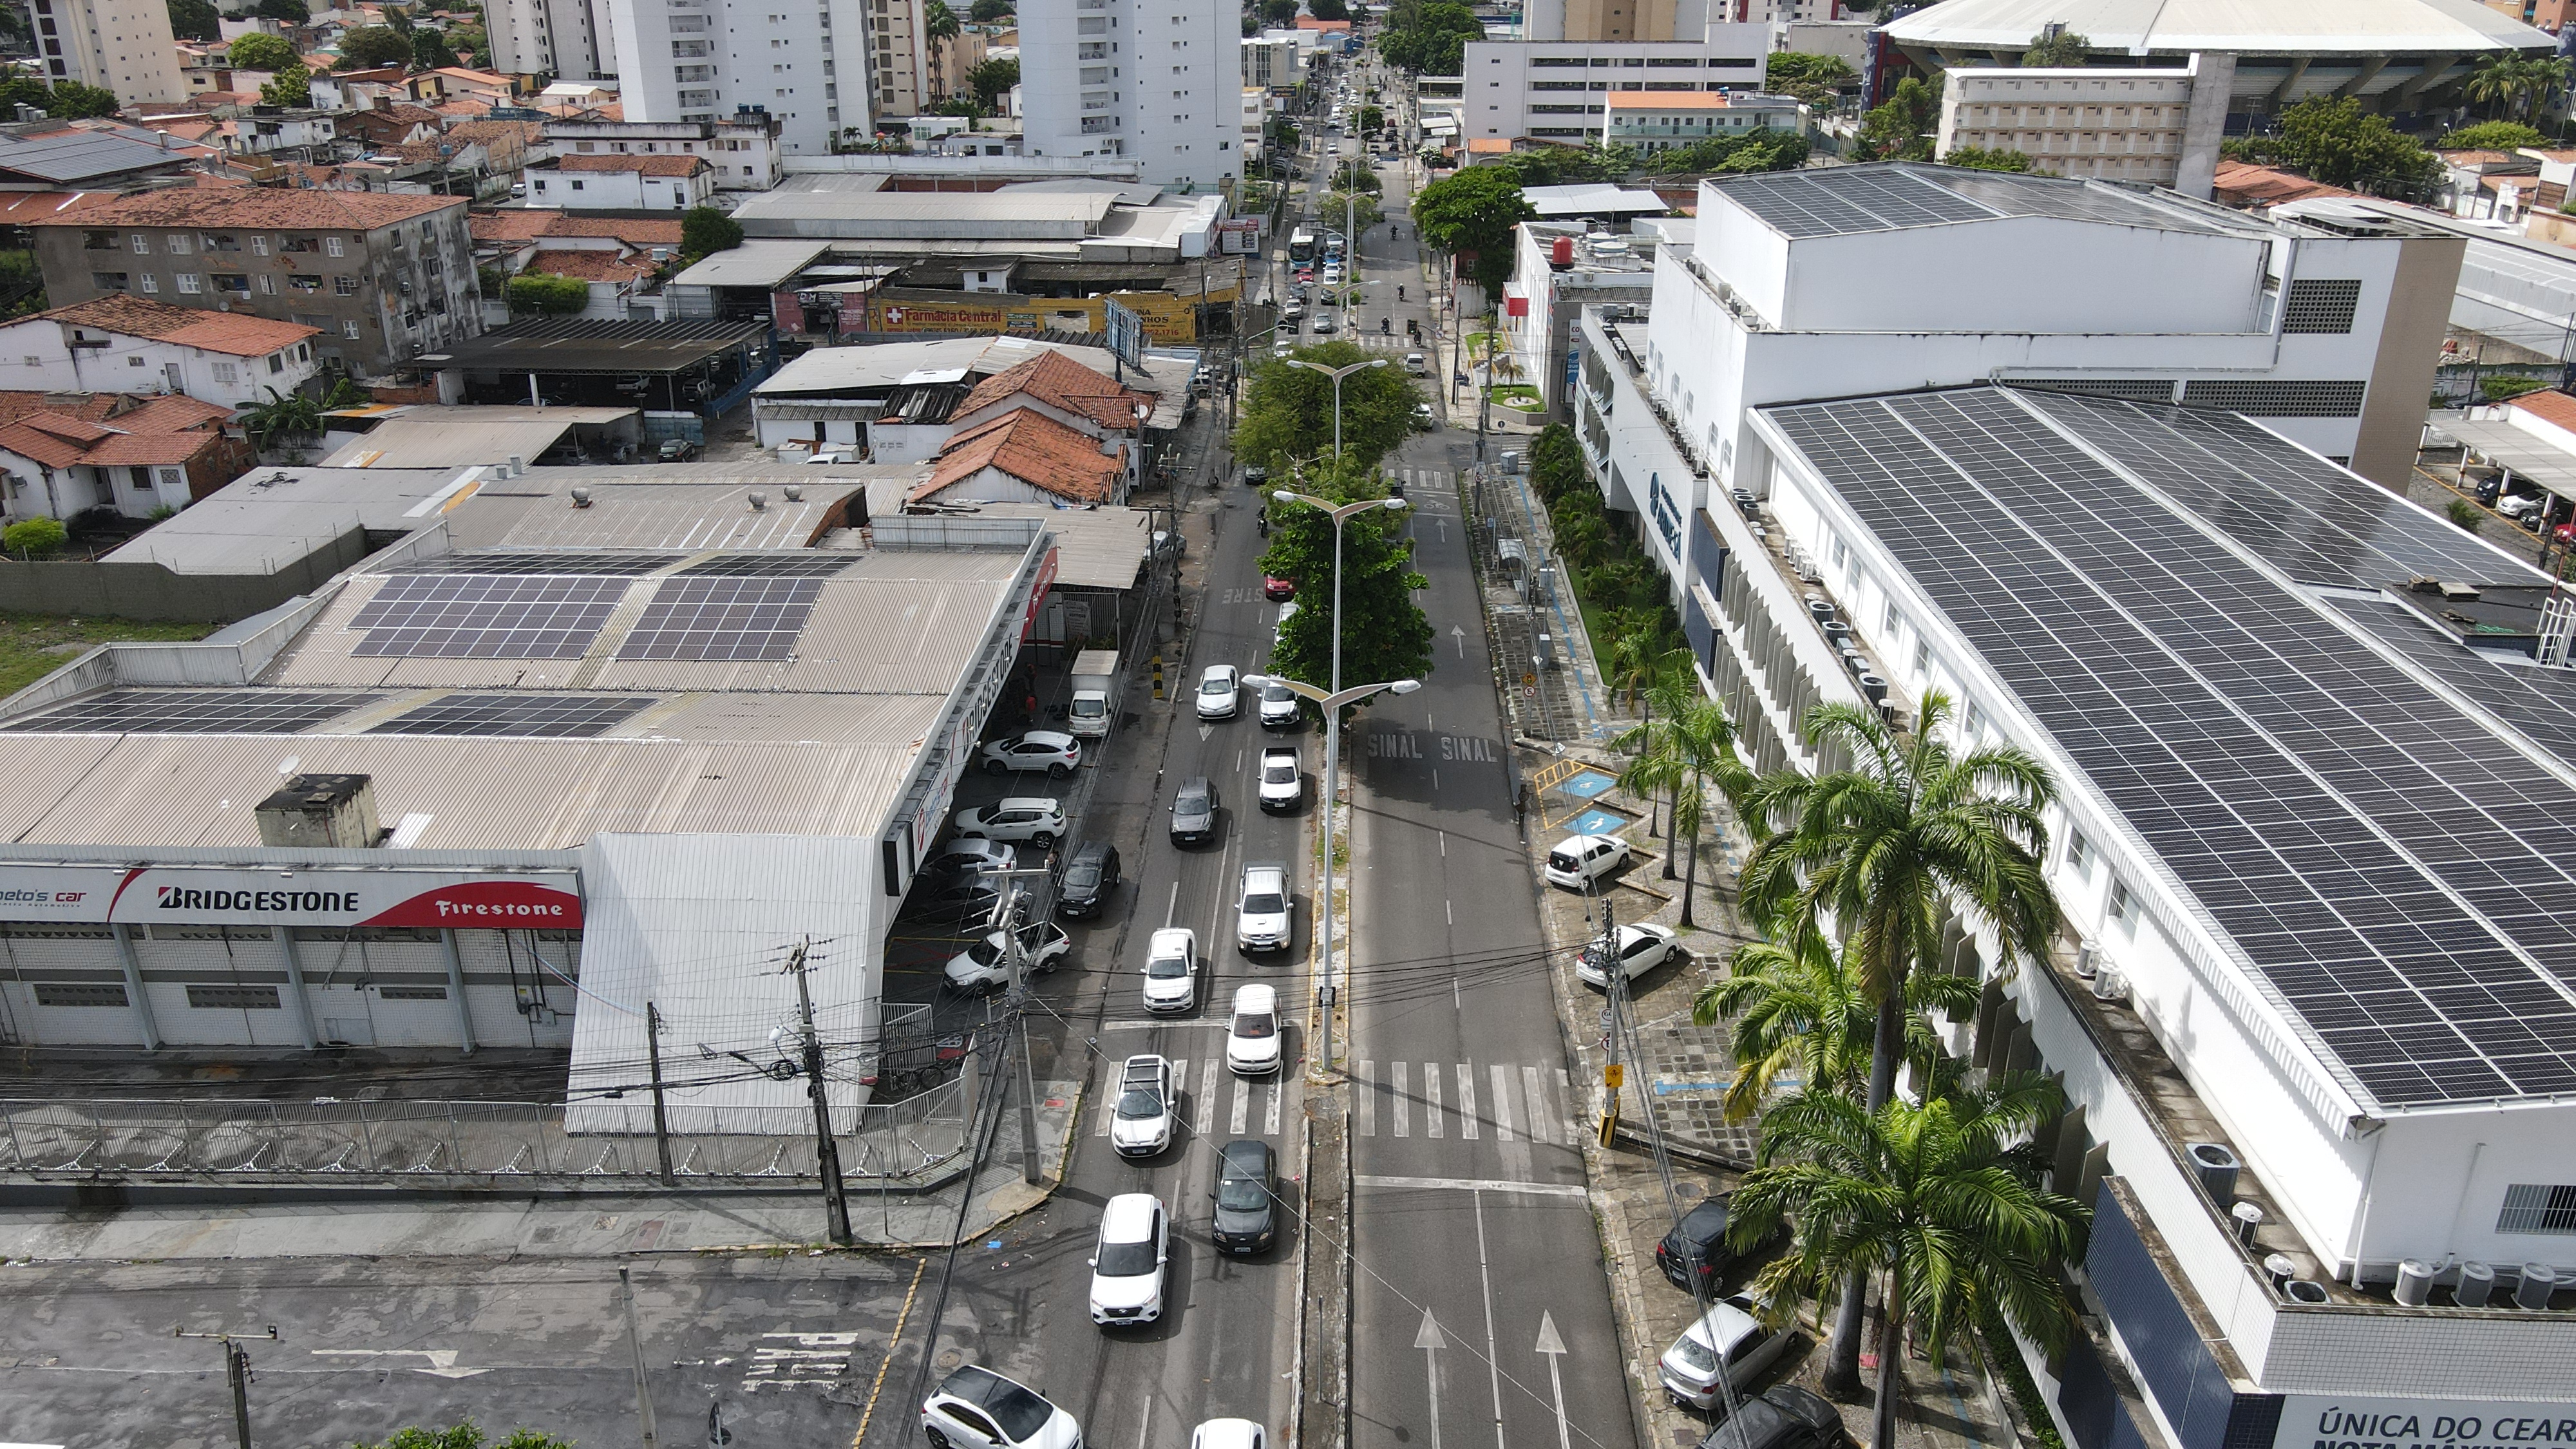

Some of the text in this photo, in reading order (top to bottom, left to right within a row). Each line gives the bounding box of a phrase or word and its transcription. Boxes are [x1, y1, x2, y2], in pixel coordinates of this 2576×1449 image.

[959, 310, 1001, 322] Central
[1367, 734, 1498, 762] SINAL SINAL
[55, 892, 87, 902] car
[158, 886, 359, 912] BRIDGESTONE
[435, 900, 563, 917] Firestone
[741, 1332, 859, 1392] PARE
[2318, 1406, 2576, 1442] ÚNICA DO CEAR
